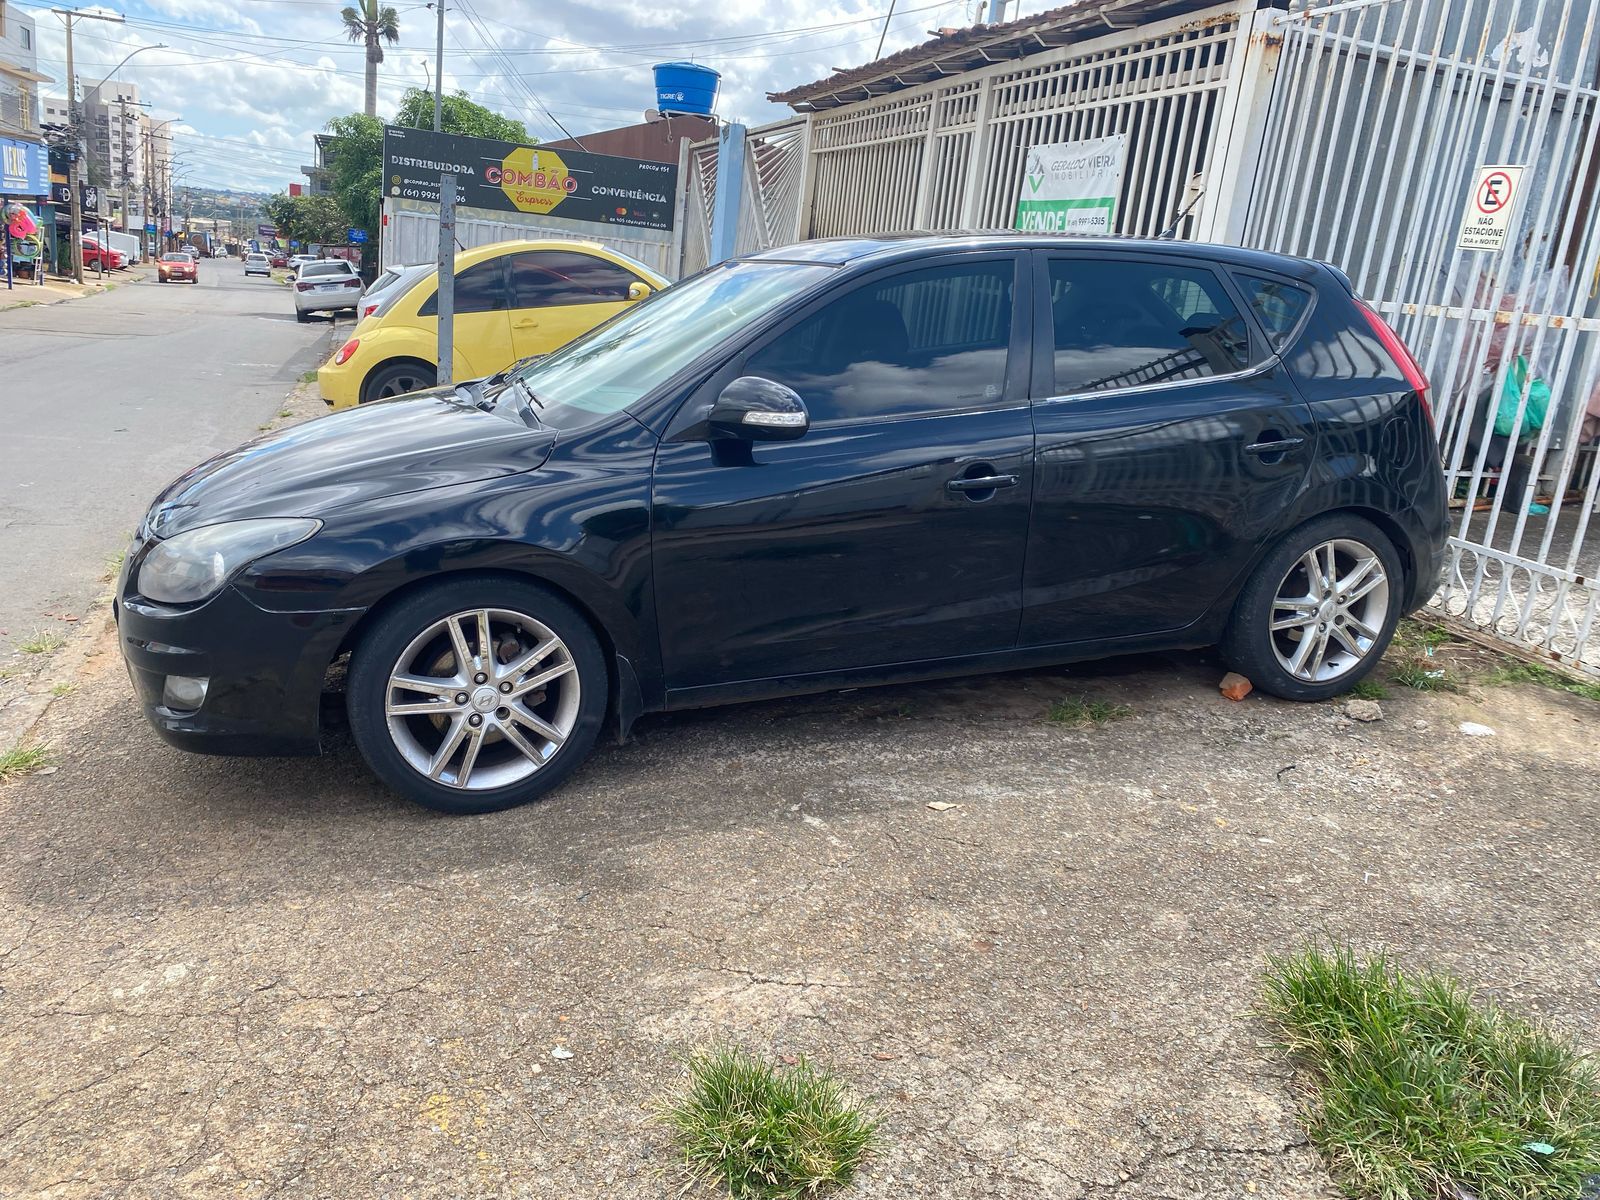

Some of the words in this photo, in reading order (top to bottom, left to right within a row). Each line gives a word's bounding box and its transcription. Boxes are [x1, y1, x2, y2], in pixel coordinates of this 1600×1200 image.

[3, 144, 27, 177] NEXUS
[391, 155, 475, 175] DISTRIBUIDORA
[1051, 158, 1087, 171] GERALDO
[1088, 154, 1116, 169] VIEIRA
[485, 166, 578, 193] COMBÃO
[402, 188, 420, 198] (61)
[515, 191, 554, 206] Express
[591, 185, 667, 203] CONVENIÊNCIA
[1021, 210, 1065, 231] VENDE
[1478, 215, 1494, 226] NÃO
[1463, 226, 1504, 237] ESTACIONE
[1480, 238, 1500, 246] NOITE
